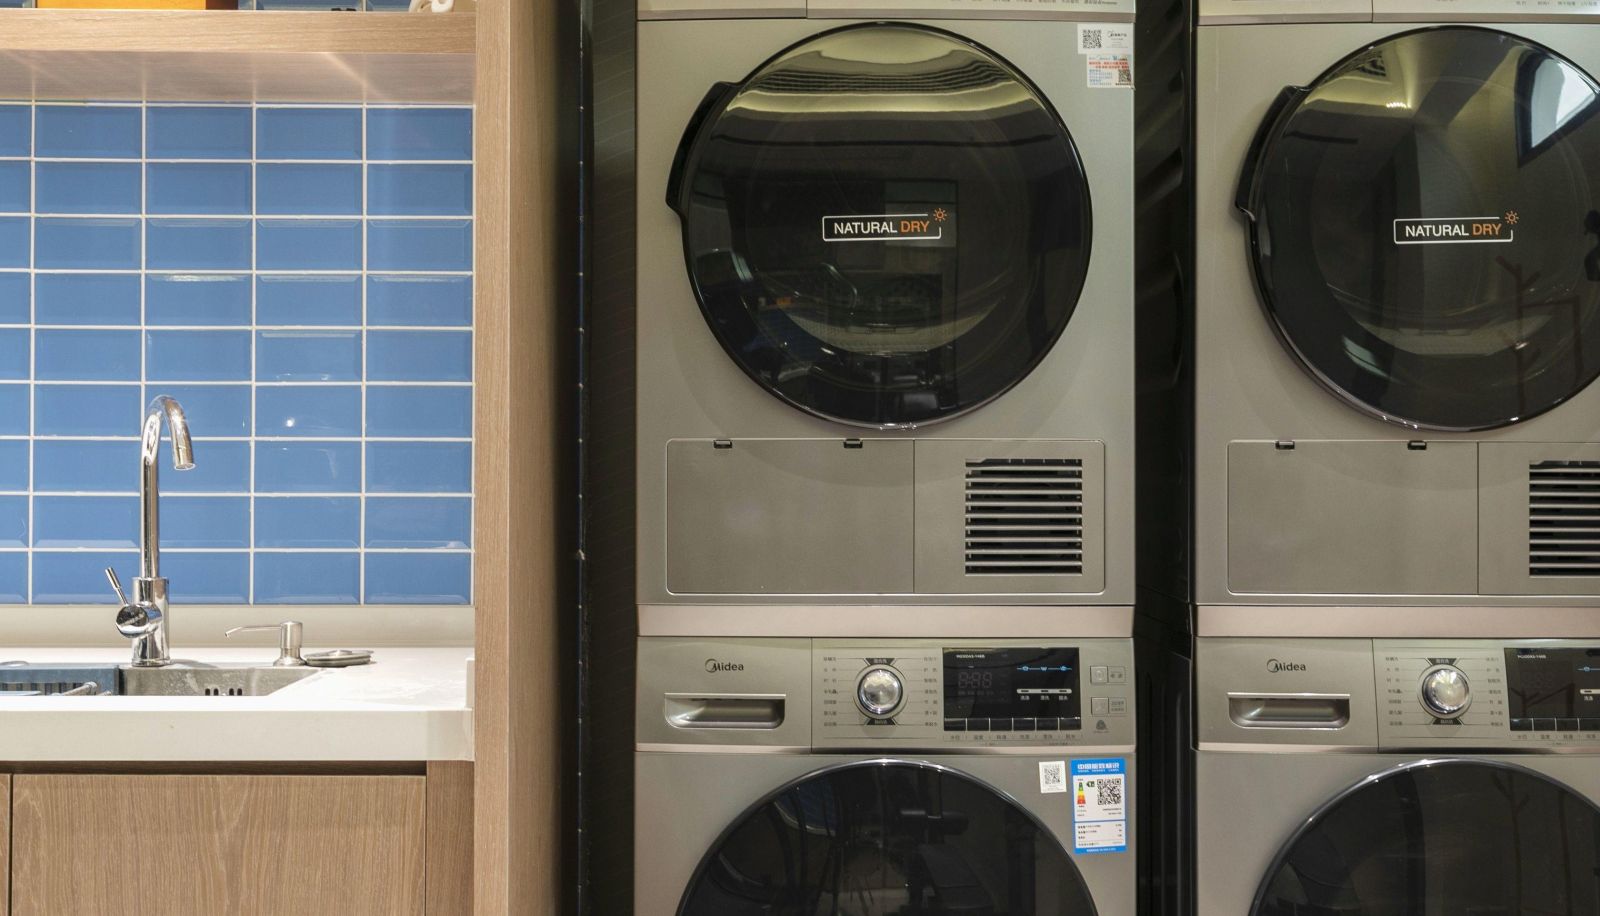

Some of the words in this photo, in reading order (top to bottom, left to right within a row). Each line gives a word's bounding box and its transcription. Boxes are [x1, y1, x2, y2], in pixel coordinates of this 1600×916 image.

[834, 221, 897, 234] NATURAL
[901, 220, 929, 233] DRY
[1405, 224, 1469, 237] NATURAL
[1472, 223, 1502, 236] DRY
[705, 658, 744, 673] Midea
[1267, 658, 1306, 673] Midea
